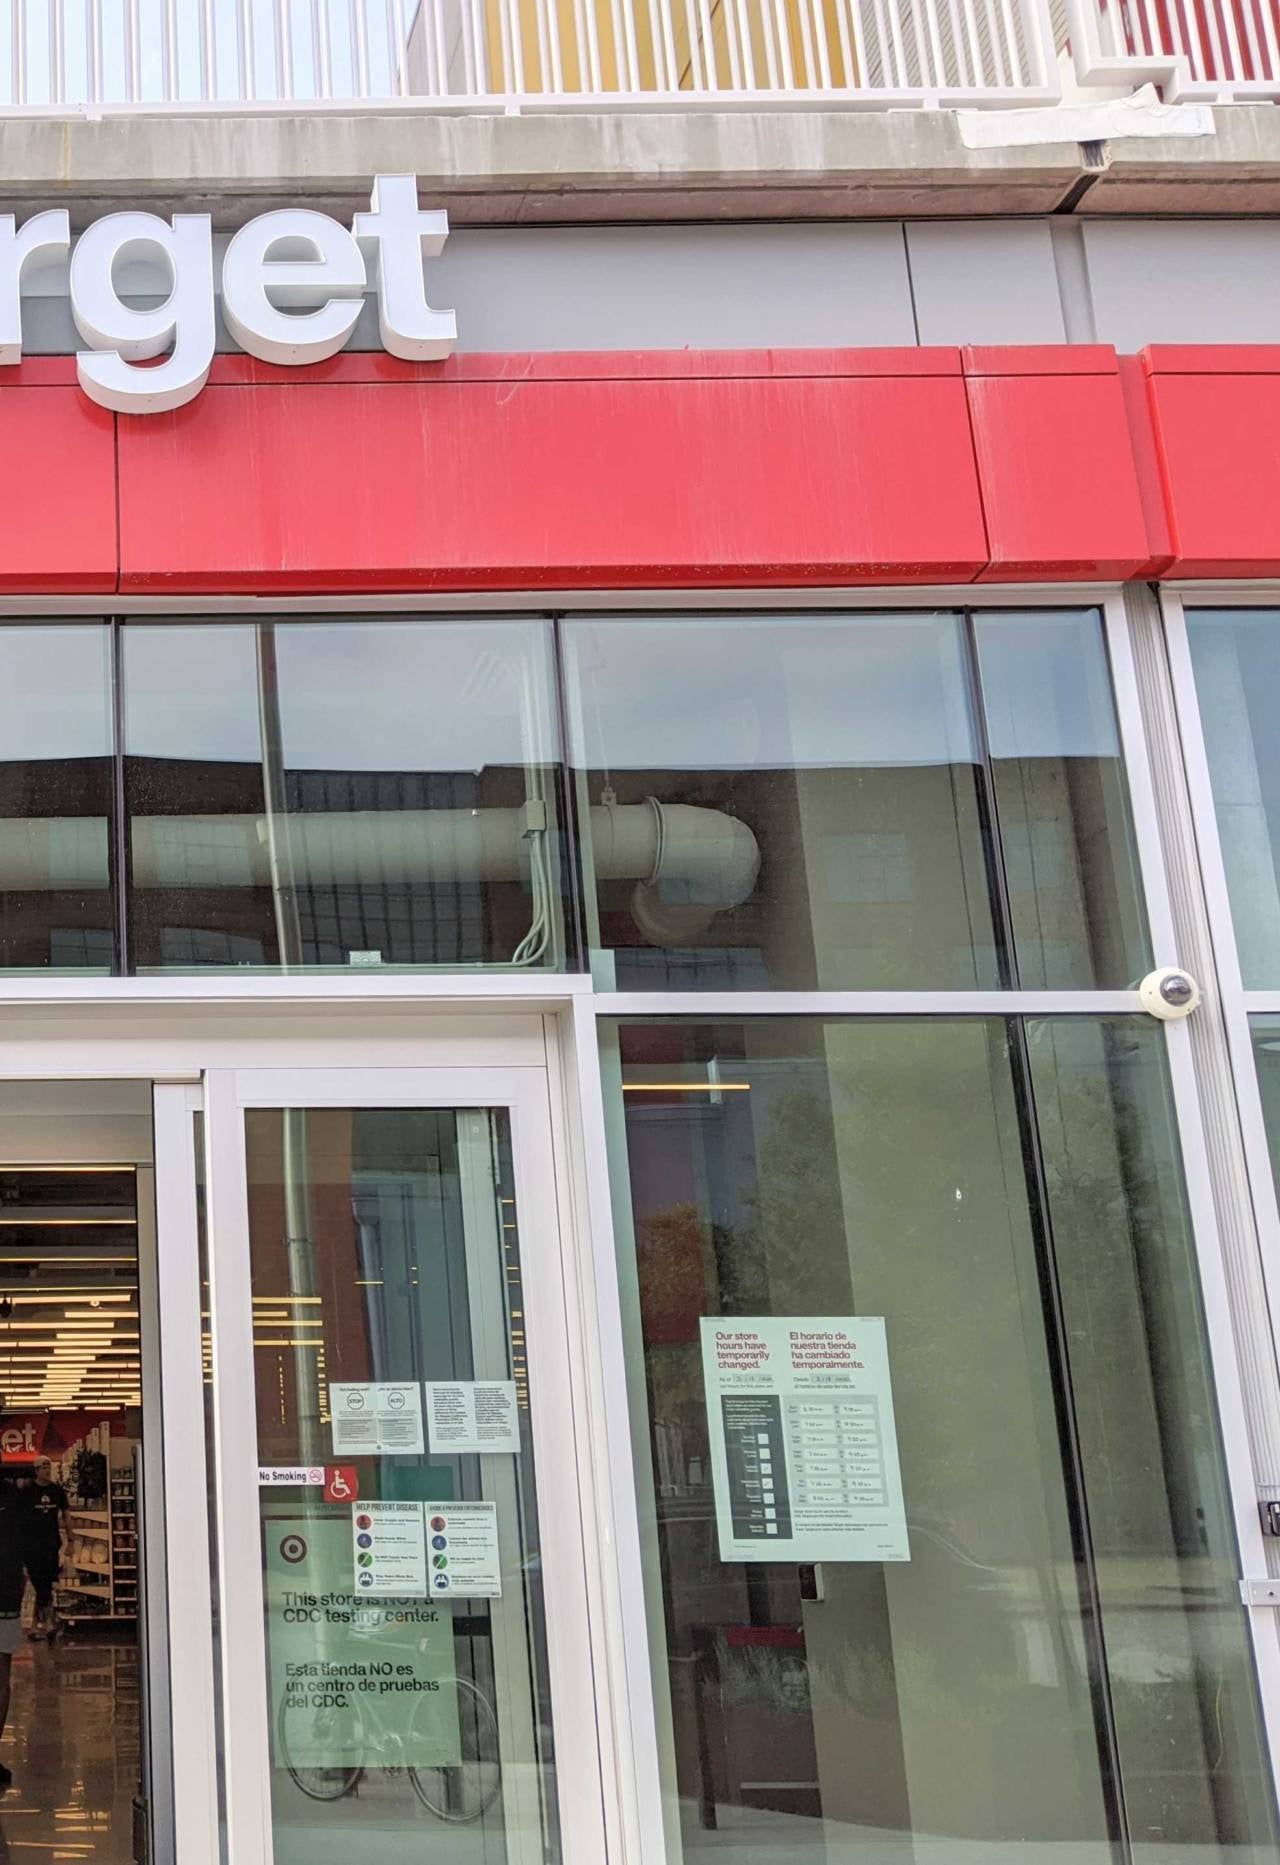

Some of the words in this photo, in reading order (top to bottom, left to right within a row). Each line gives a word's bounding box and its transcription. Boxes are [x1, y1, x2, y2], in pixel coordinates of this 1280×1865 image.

[715, 1331, 733, 1340] Our
[735, 1332, 758, 1340] store
[789, 1331, 799, 1340] El
[800, 1331, 833, 1340] horario
[834, 1331, 847, 1340] de
[716, 1341, 743, 1350] hours
[744, 1341, 767, 1350] have
[790, 1342, 826, 1350] nuestra
[827, 1341, 857, 1350] tienda
[717, 1350, 770, 1360] temporarily
[791, 1351, 804, 1360] ha
[804, 1351, 851, 1360] cambiado
[718, 1360, 761, 1370] changed.
[792, 1360, 865, 1370] temporalmente.
[259, 1471, 270, 1481] No
[272, 1471, 307, 1482] Smoking
[356, 1503, 370, 1511] HELP
[371, 1503, 395, 1511] PREVENT
[396, 1503, 419, 1512] DISEASE
[282, 1591, 317, 1607] This
[320, 1592, 362, 1606] store
[366, 1596, 379, 1606] is
[383, 1596, 418, 1606] NOT
[423, 1596, 434, 1606] a
[283, 1608, 321, 1623] CDC
[325, 1609, 381, 1626] testing
[384, 1608, 439, 1623] center.
[285, 1663, 318, 1677] Esta
[321, 1662, 366, 1676] tienda
[370, 1662, 393, 1676] NO
[396, 1665, 413, 1676] es
[286, 1681, 304, 1692] un
[307, 1680, 355, 1692] centro
[358, 1679, 376, 1692] de
[379, 1678, 440, 1694] pruebas
[286, 1695, 309, 1708] del
[311, 1695, 349, 1708] CDC.
